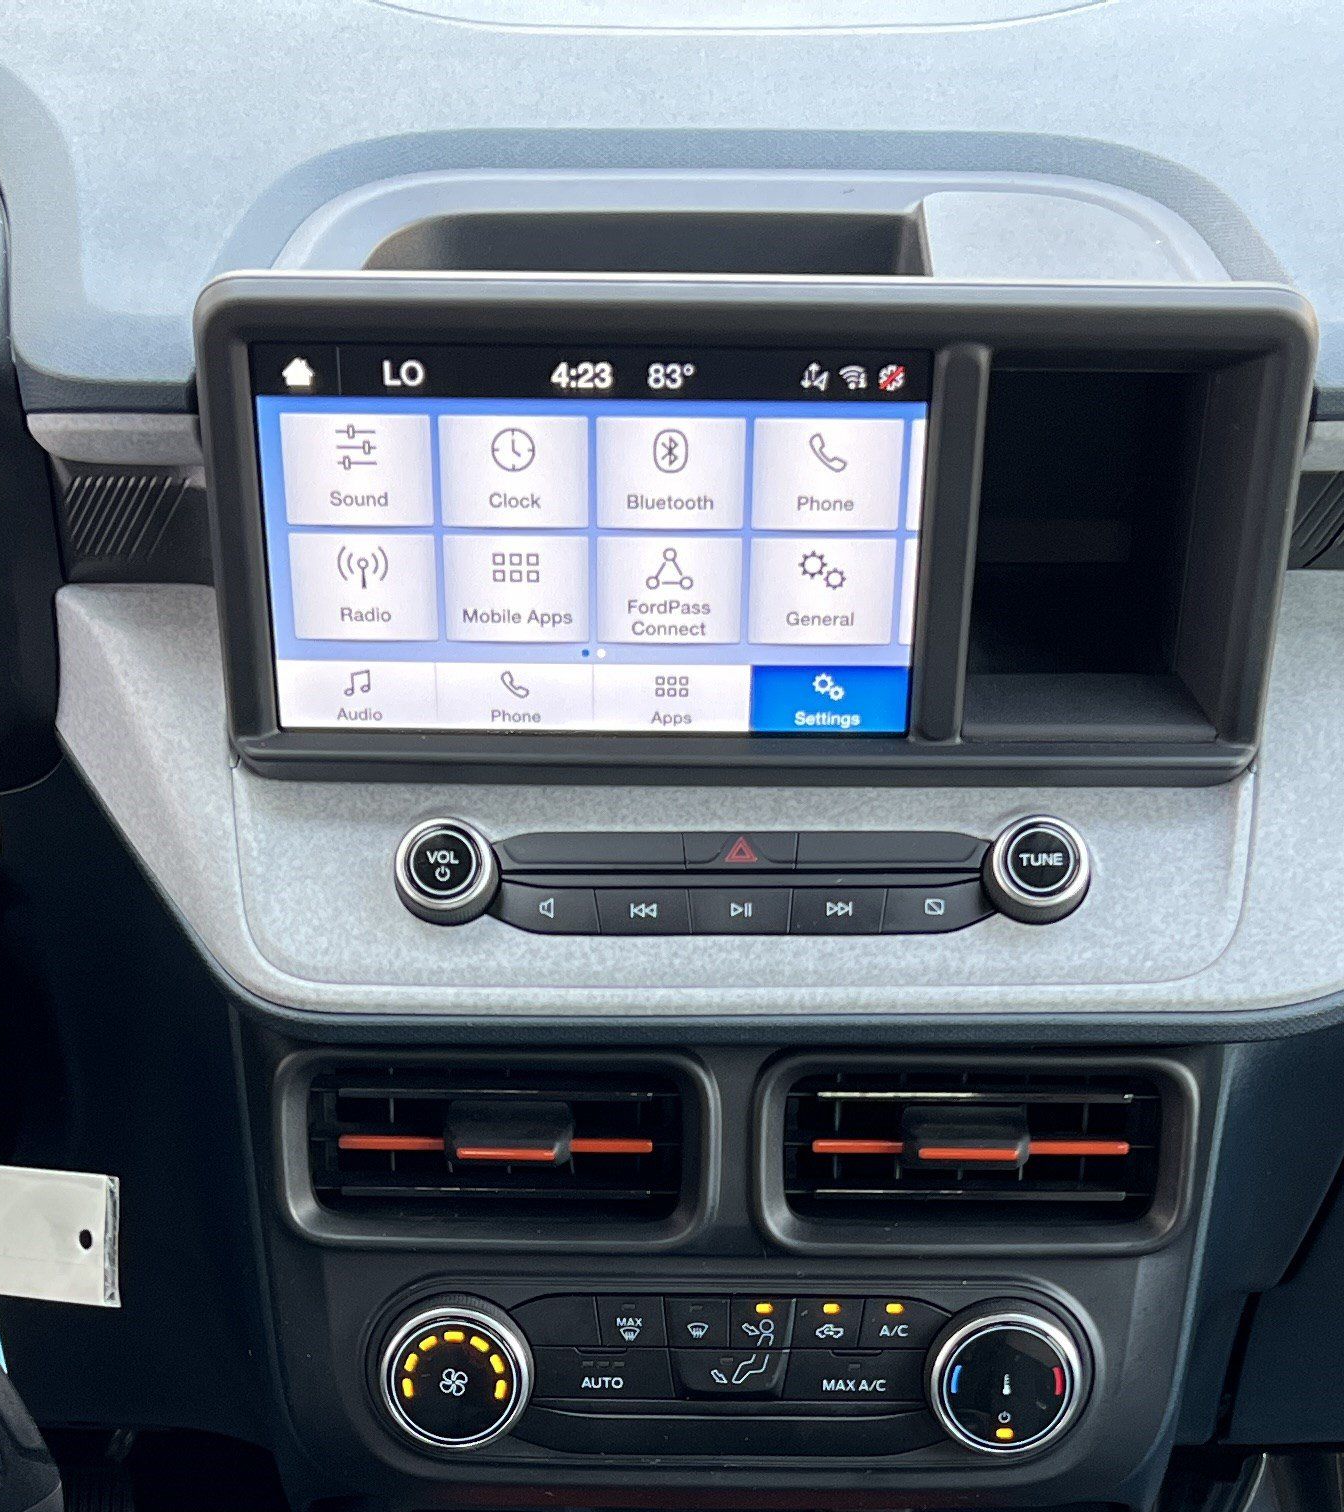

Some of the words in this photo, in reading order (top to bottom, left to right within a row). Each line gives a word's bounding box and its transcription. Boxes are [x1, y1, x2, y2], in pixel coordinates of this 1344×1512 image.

[383, 361, 424, 387] LO
[551, 363, 613, 389] 4:23
[648, 363, 694, 388] 83°
[329, 489, 389, 510] Sound
[488, 491, 542, 511] Clock
[626, 492, 715, 512] Bluetooth
[796, 494, 856, 514] Phone
[340, 605, 393, 624] Radio
[627, 599, 712, 617] FordPass
[462, 607, 523, 626] Mobile
[527, 608, 574, 630] Apps
[786, 609, 856, 629] General
[631, 620, 707, 639] Connect
[337, 706, 384, 723] Audio
[490, 707, 542, 725] Phone
[651, 709, 693, 728] Apps
[794, 709, 861, 730] Settings
[426, 850, 459, 866] VOL
[1019, 852, 1064, 868] TUNE
[616, 1316, 643, 1328] MAX
[879, 1323, 909, 1338] A/C
[581, 1376, 624, 1390] AUTO
[822, 1378, 855, 1392] MAX
[858, 1378, 886, 1393] A/C
